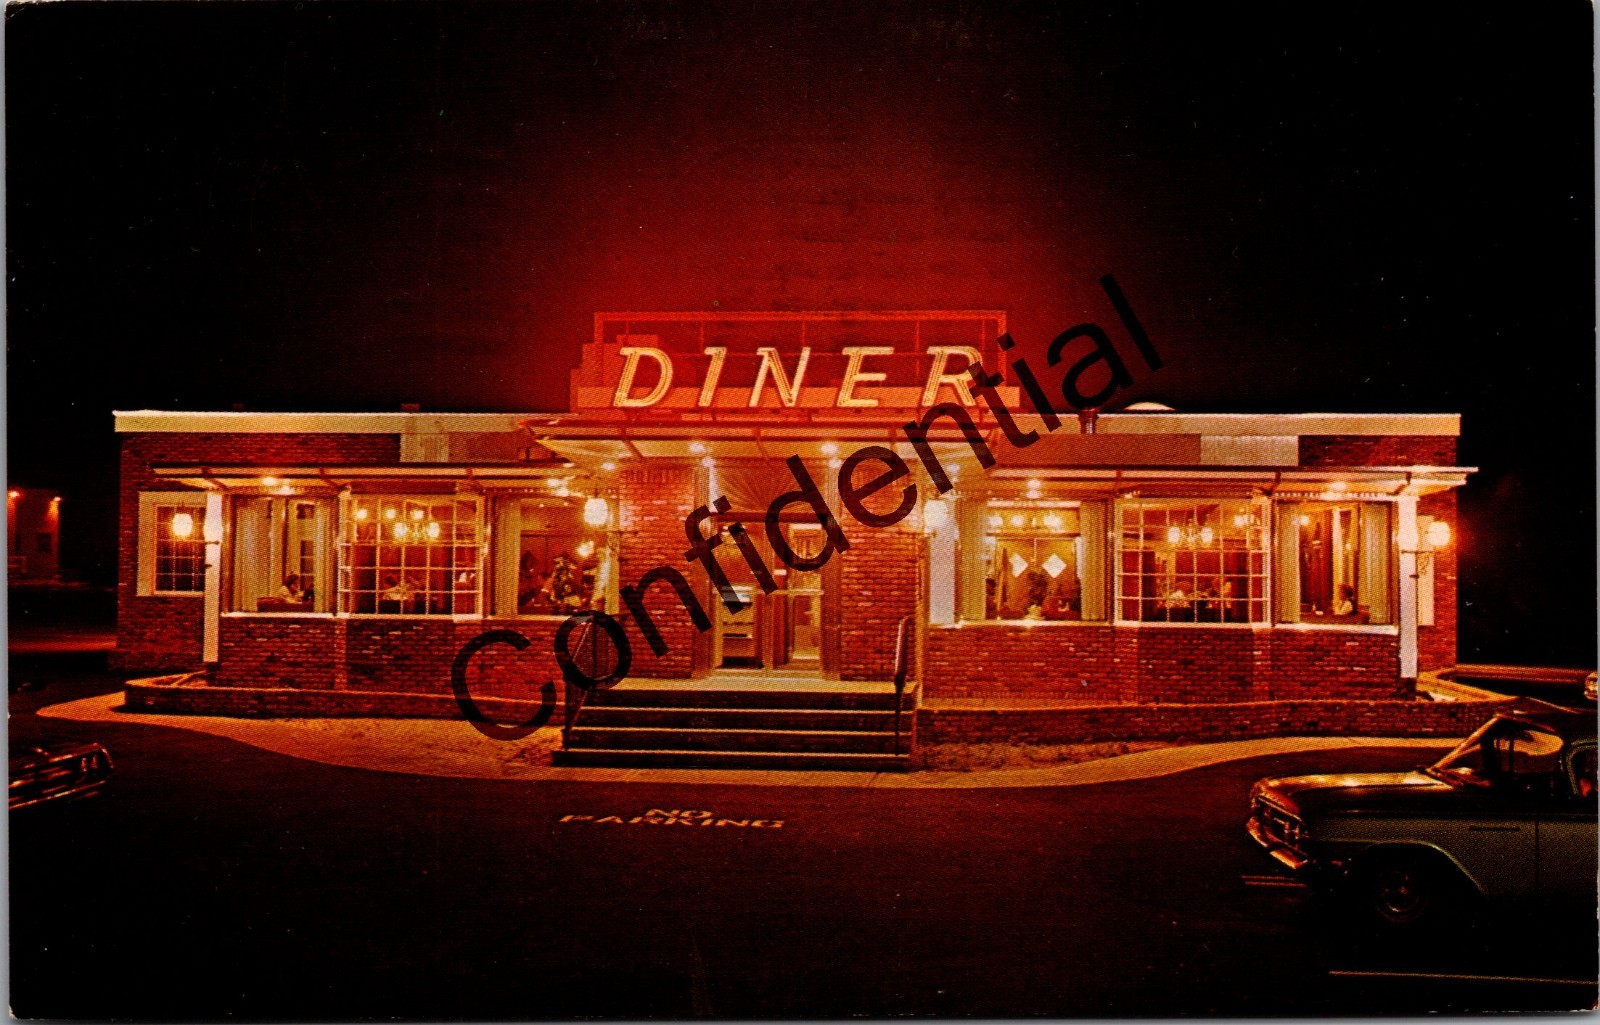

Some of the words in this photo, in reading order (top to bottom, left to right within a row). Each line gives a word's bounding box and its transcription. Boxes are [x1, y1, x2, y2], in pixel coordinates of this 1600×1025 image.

[613, 346, 983, 407] DINER
[645, 807, 714, 819] NO
[559, 814, 785, 829] PARKING
